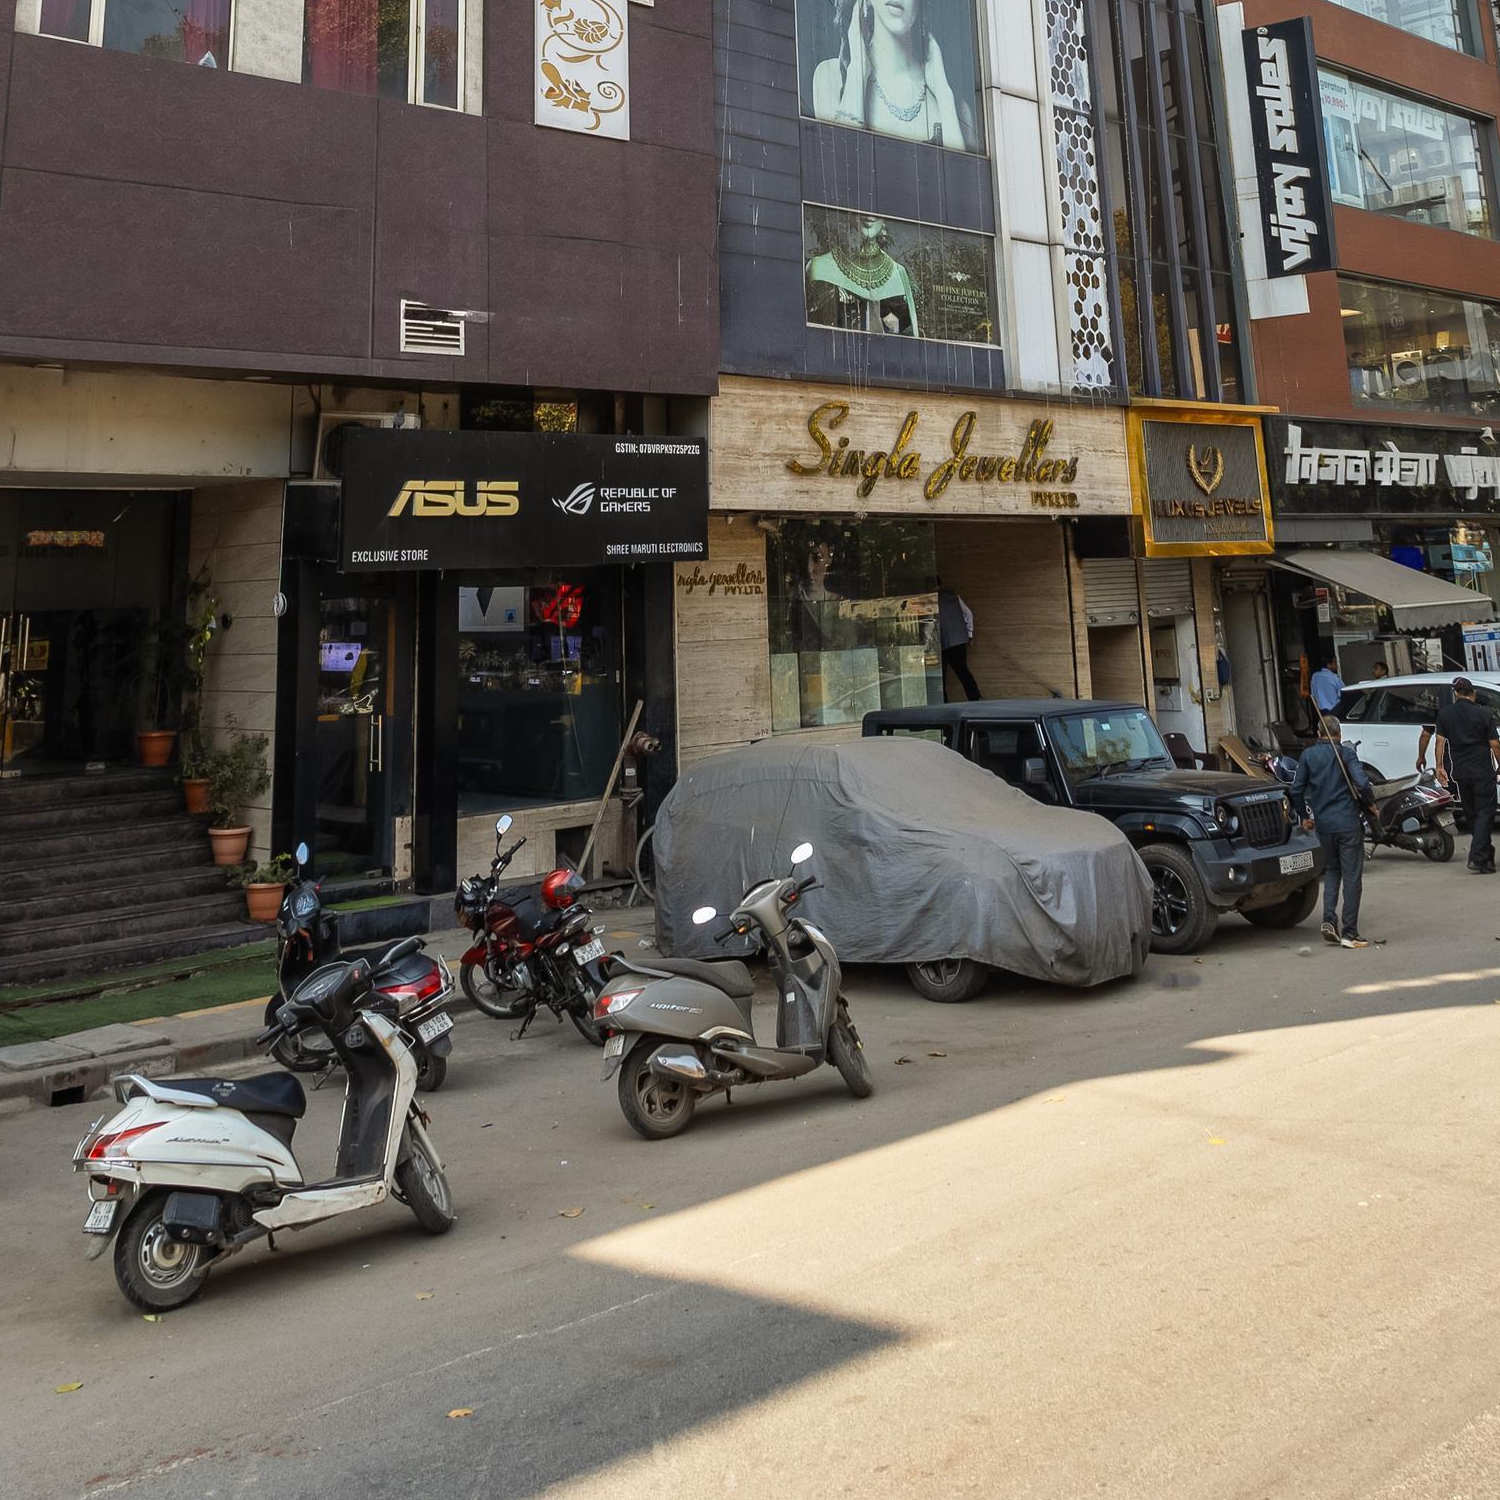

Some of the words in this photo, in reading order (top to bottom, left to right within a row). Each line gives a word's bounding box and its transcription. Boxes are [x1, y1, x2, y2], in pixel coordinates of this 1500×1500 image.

[615, 443, 638, 453] GSTIN:
[785, 400, 922, 500] Singla
[923, 410, 1080, 501] Jewellers
[387, 480, 520, 517] ASUS
[600, 487, 660, 499] REPUBLIC
[661, 487, 677, 499] OF
[600, 501, 651, 513] GAMERS
[606, 544, 629, 555] SHREE
[630, 543, 658, 554] MARUTI
[658, 542, 704, 554] ELECTRONICS
[351, 550, 400, 563] EXCLUSIVE
[400, 549, 429, 562] STORE
